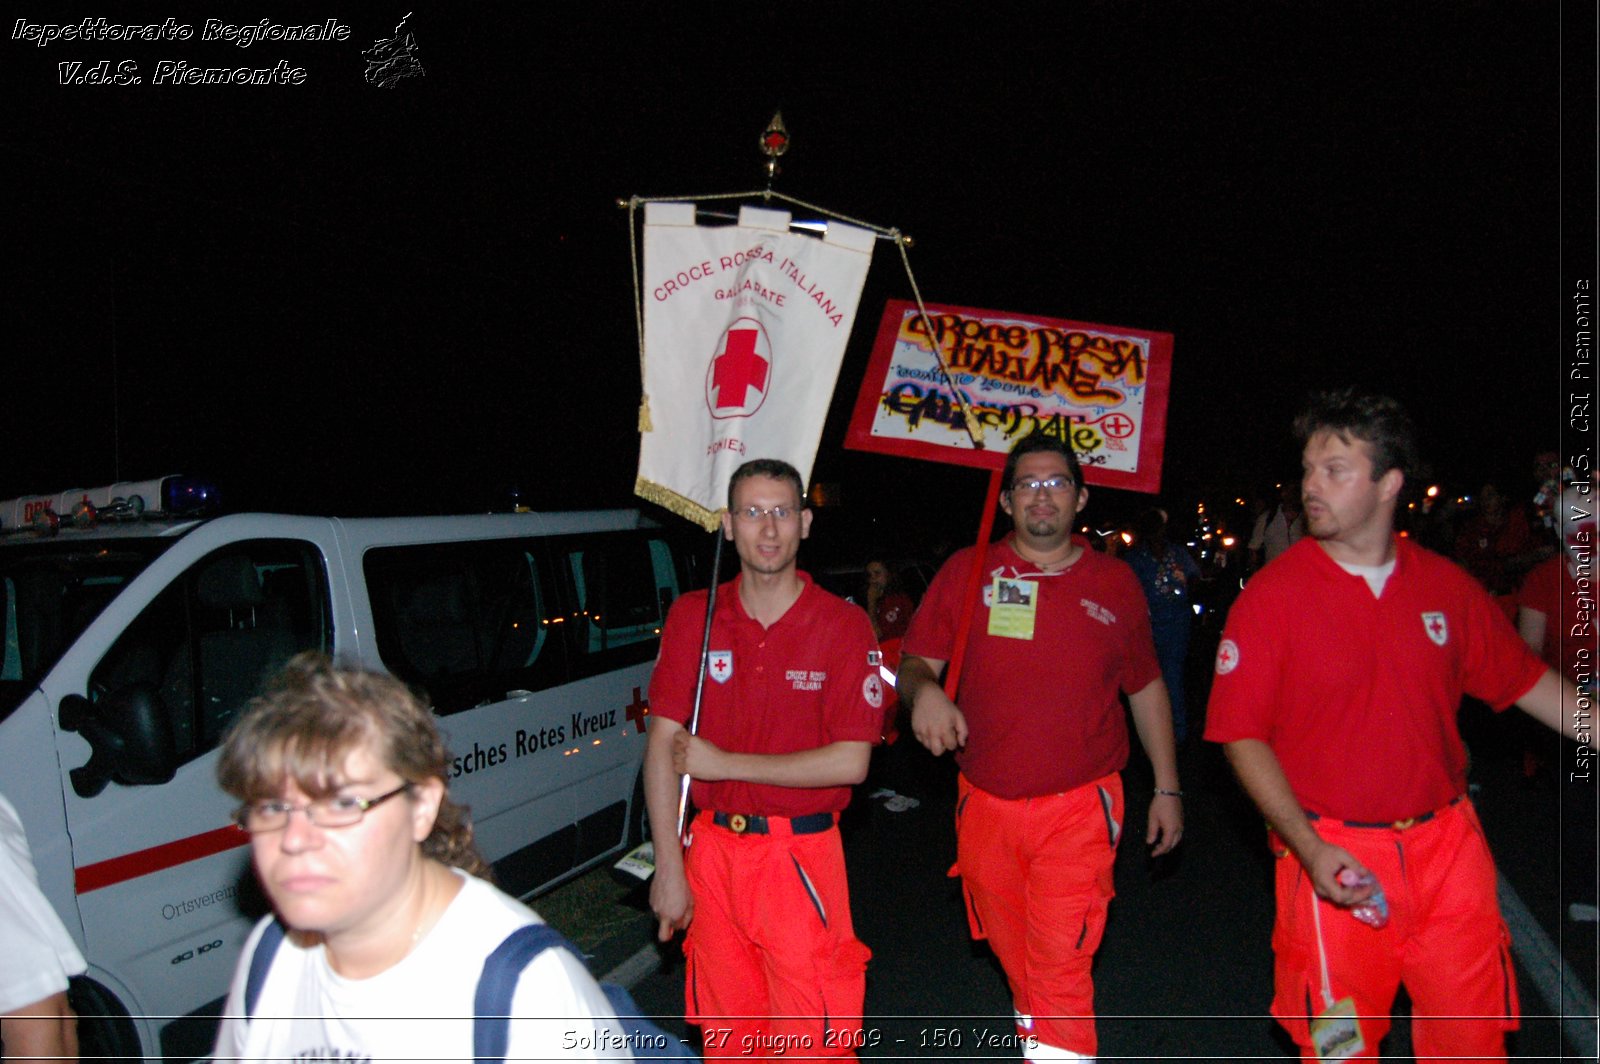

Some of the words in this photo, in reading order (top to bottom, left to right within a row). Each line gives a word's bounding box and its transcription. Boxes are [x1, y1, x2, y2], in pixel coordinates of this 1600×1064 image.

[653, 260, 715, 303] CROCE
[720, 246, 775, 271] ROSSA
[779, 257, 845, 328] ITALIANA
[714, 278, 787, 308] GALLARATE
[447, 742, 507, 779] sches
[515, 729, 565, 759] Rotes
[571, 709, 617, 740] Kreuz
[161, 885, 237, 920] Ortsverein
